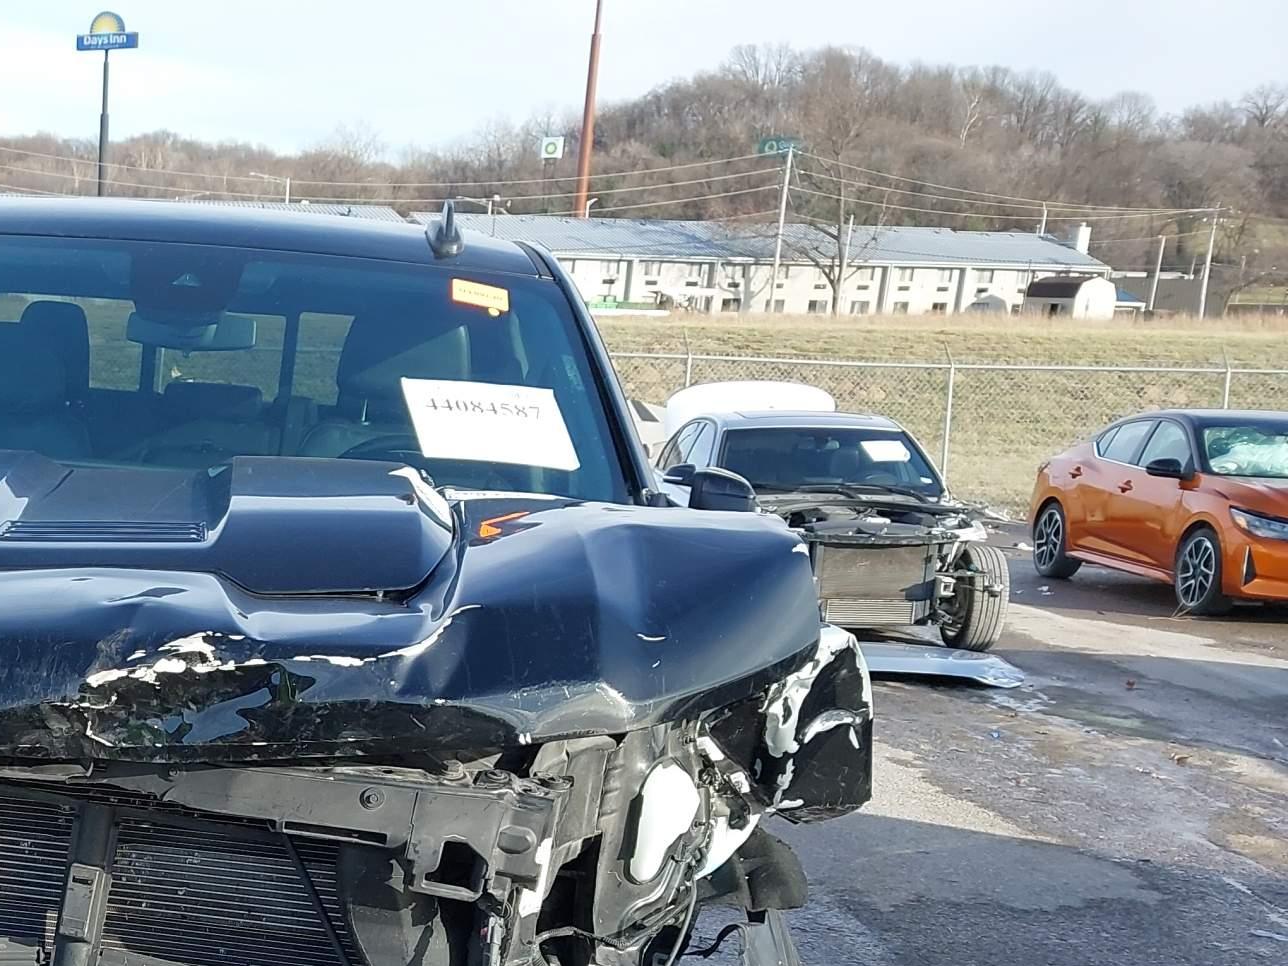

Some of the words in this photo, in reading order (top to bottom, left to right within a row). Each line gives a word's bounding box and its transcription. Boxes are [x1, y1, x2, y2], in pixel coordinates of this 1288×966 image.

[83, 34, 109, 47] Days
[109, 34, 127, 44] Inn
[425, 398, 541, 420] 44084587
